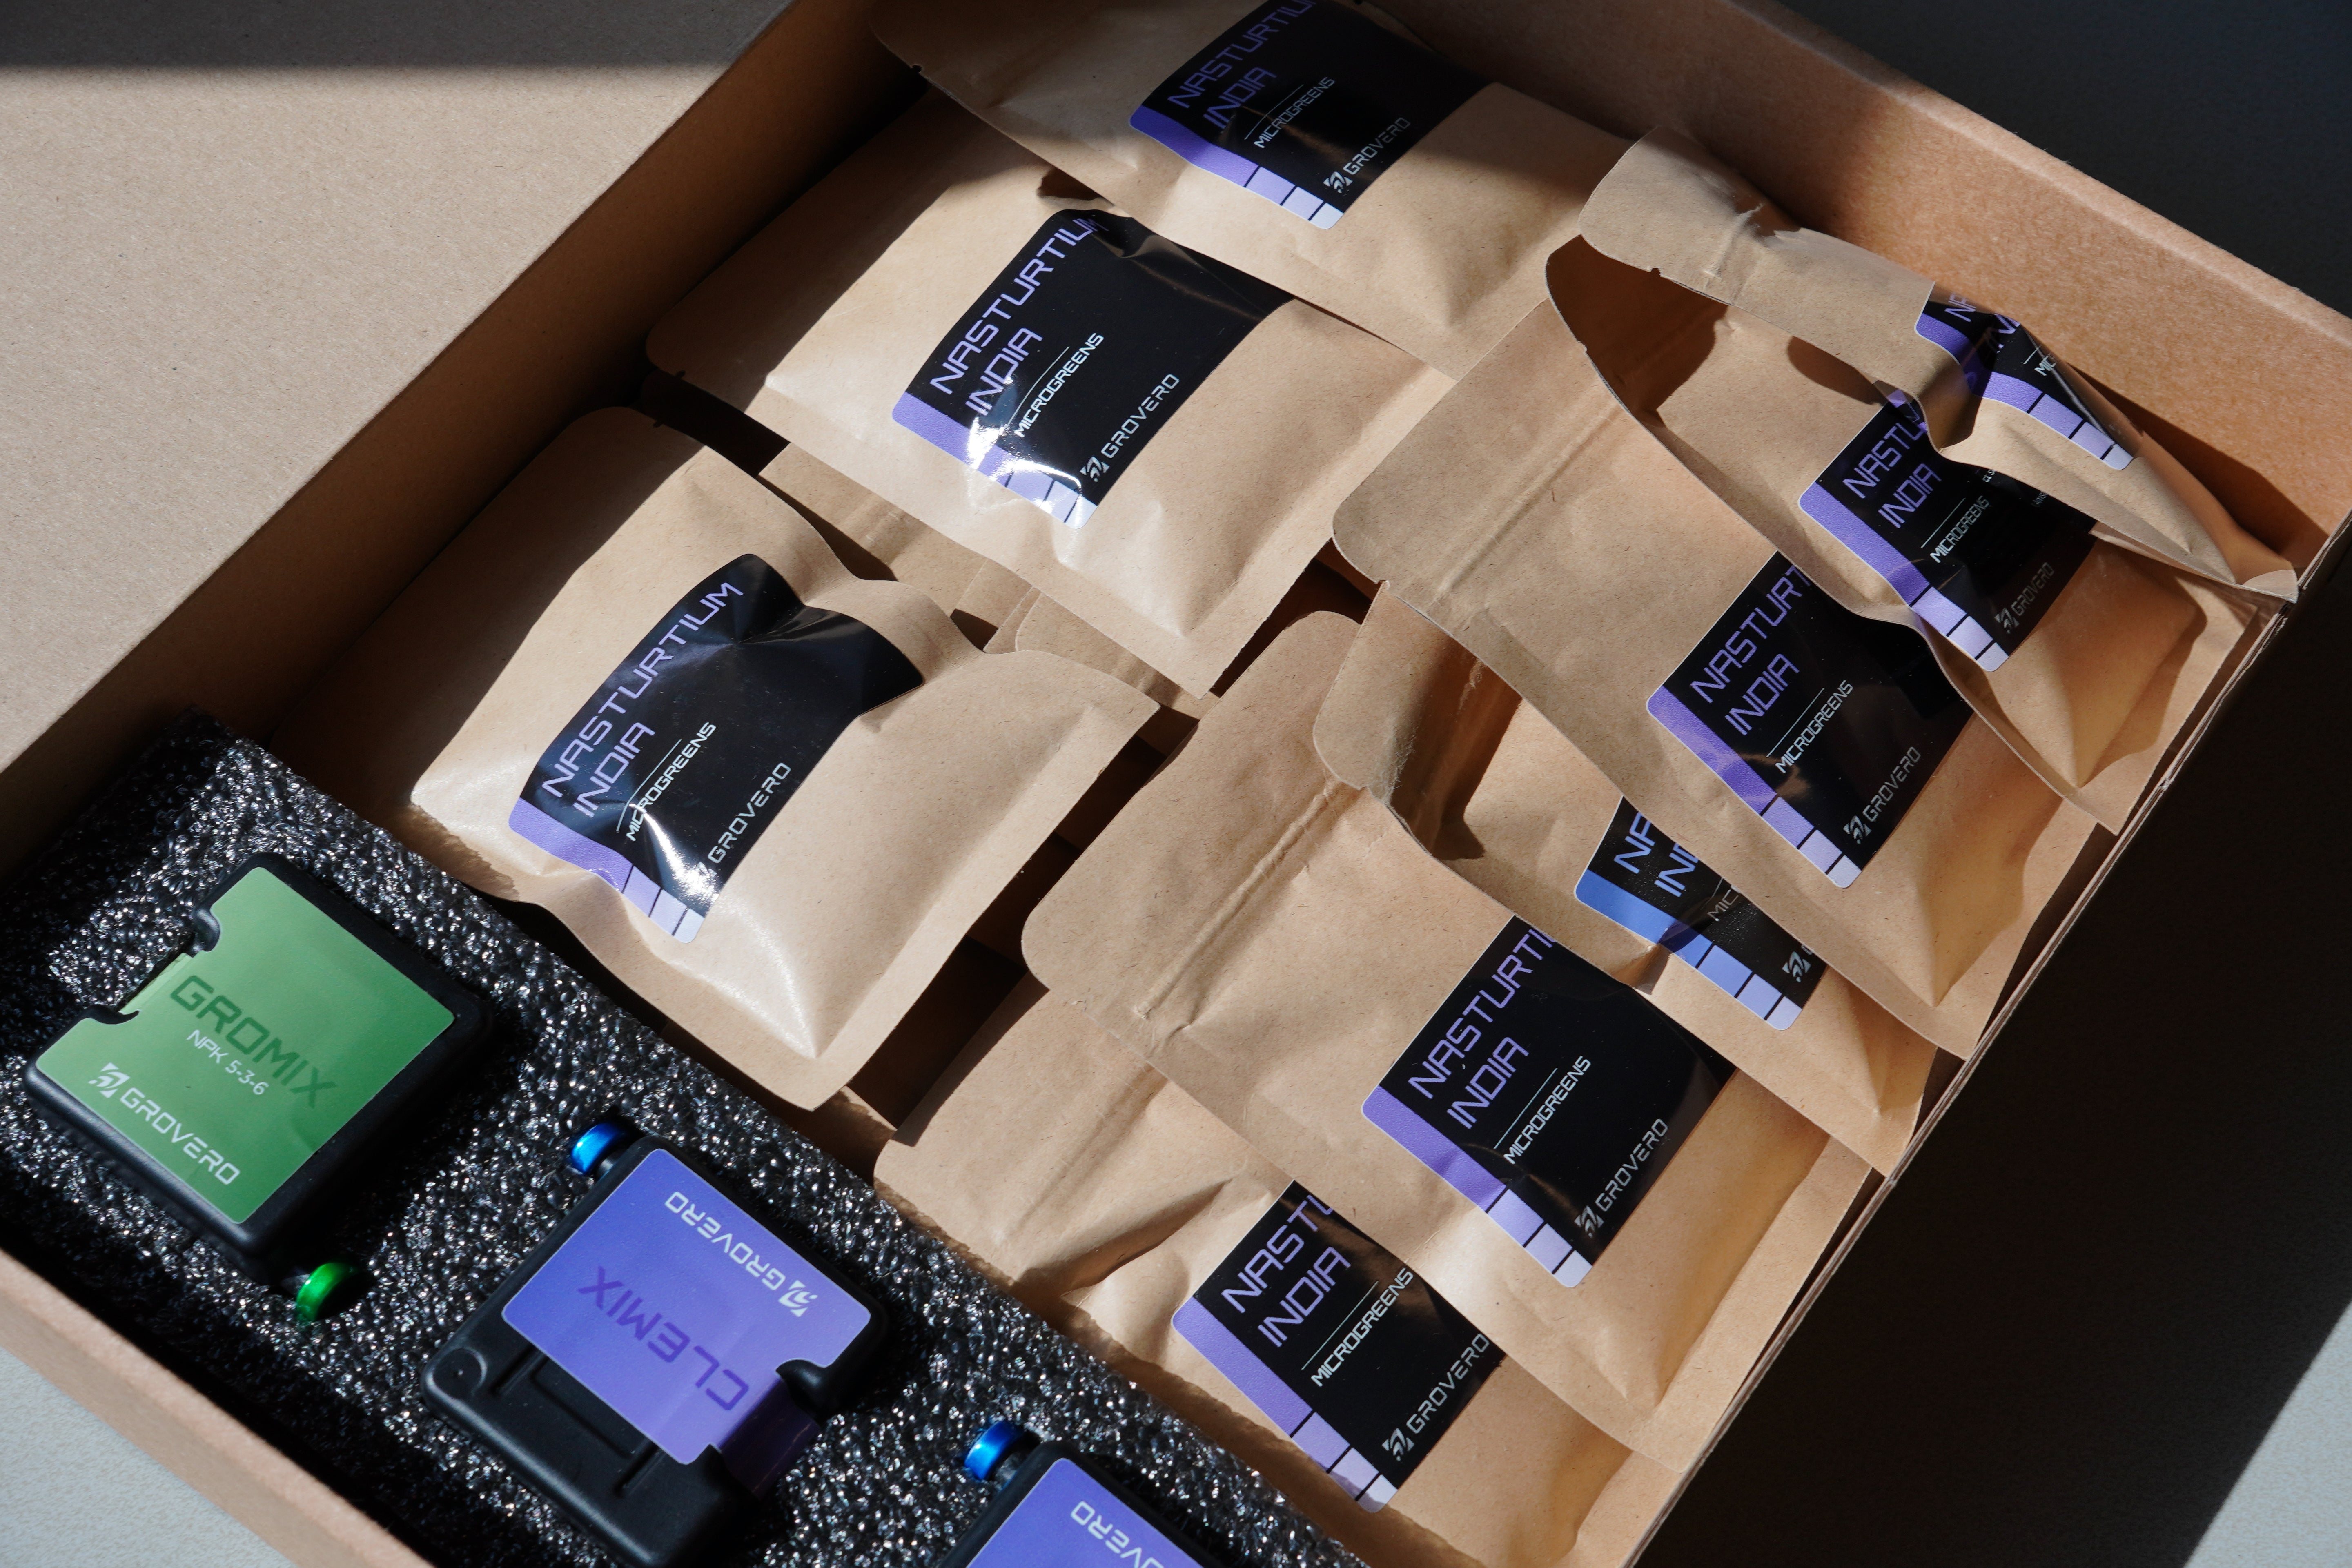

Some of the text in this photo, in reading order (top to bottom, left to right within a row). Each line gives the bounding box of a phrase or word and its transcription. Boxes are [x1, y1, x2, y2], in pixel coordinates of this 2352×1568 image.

[1167, 0, 1316, 108] NASTURTIU
[1203, 67, 1277, 129] INDIA
[1254, 77, 1335, 149] MICROGREENS
[1343, 117, 1411, 175] GROVERO
[930, 218, 1109, 395] NASTURTIUM
[966, 328, 1042, 416] INDIA
[1014, 333, 1104, 437] MICROGREENS
[1101, 374, 1179, 459] GROVERO
[1878, 463, 1942, 528] INDIA
[1929, 495, 1990, 563] MICROGREENS
[2011, 562, 2054, 617] GROVERO
[541, 582, 743, 798] NASTURTIUM
[1724, 654, 1800, 735] INDIA
[1775, 680, 1853, 774] MICROGREENS
[573, 722, 655, 817] INDIA
[626, 722, 716, 841] MICROGREENS
[708, 762, 791, 864] GROVERO
[1863, 747, 1921, 822] GROVERO
[170, 975, 337, 1109] GROMIX
[1408, 929, 1555, 1099] NASTURTI
[187, 1030, 268, 1095] NPK 5-3-6
[1447, 1037, 1529, 1129] INDIA
[1503, 1056, 1591, 1164] MICROGREENS
[120, 1087, 240, 1185] GROVERO
[1596, 1118, 1668, 1212] GROVERO
[664, 1191, 786, 1291] GROVERO
[577, 1266, 749, 1411] CLEMIX
[1258, 1247, 1351, 1348] INDIA
[1311, 1268, 1413, 1387] MICROGREENS
[1406, 1333, 1490, 1434] GROVERO
